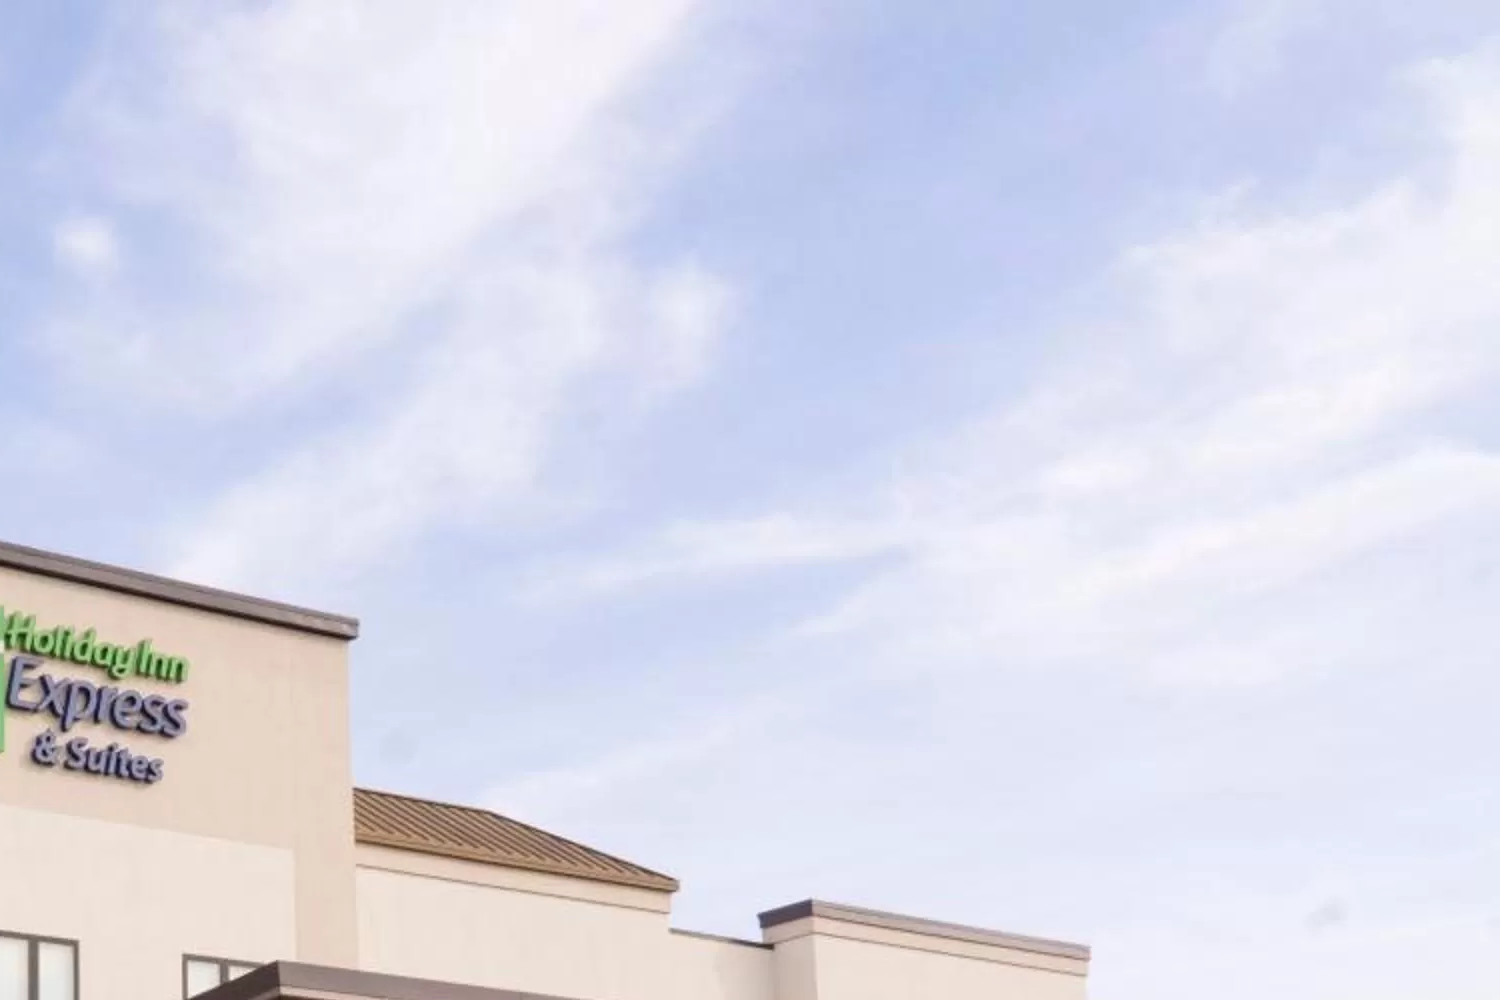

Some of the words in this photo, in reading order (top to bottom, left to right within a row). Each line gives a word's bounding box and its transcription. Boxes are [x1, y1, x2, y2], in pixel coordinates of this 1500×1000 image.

[4, 611, 133, 679] Holiday
[137, 638, 188, 684] Inn
[5, 655, 188, 738] Express
[31, 729, 60, 766] &
[64, 736, 165, 784] Suites
